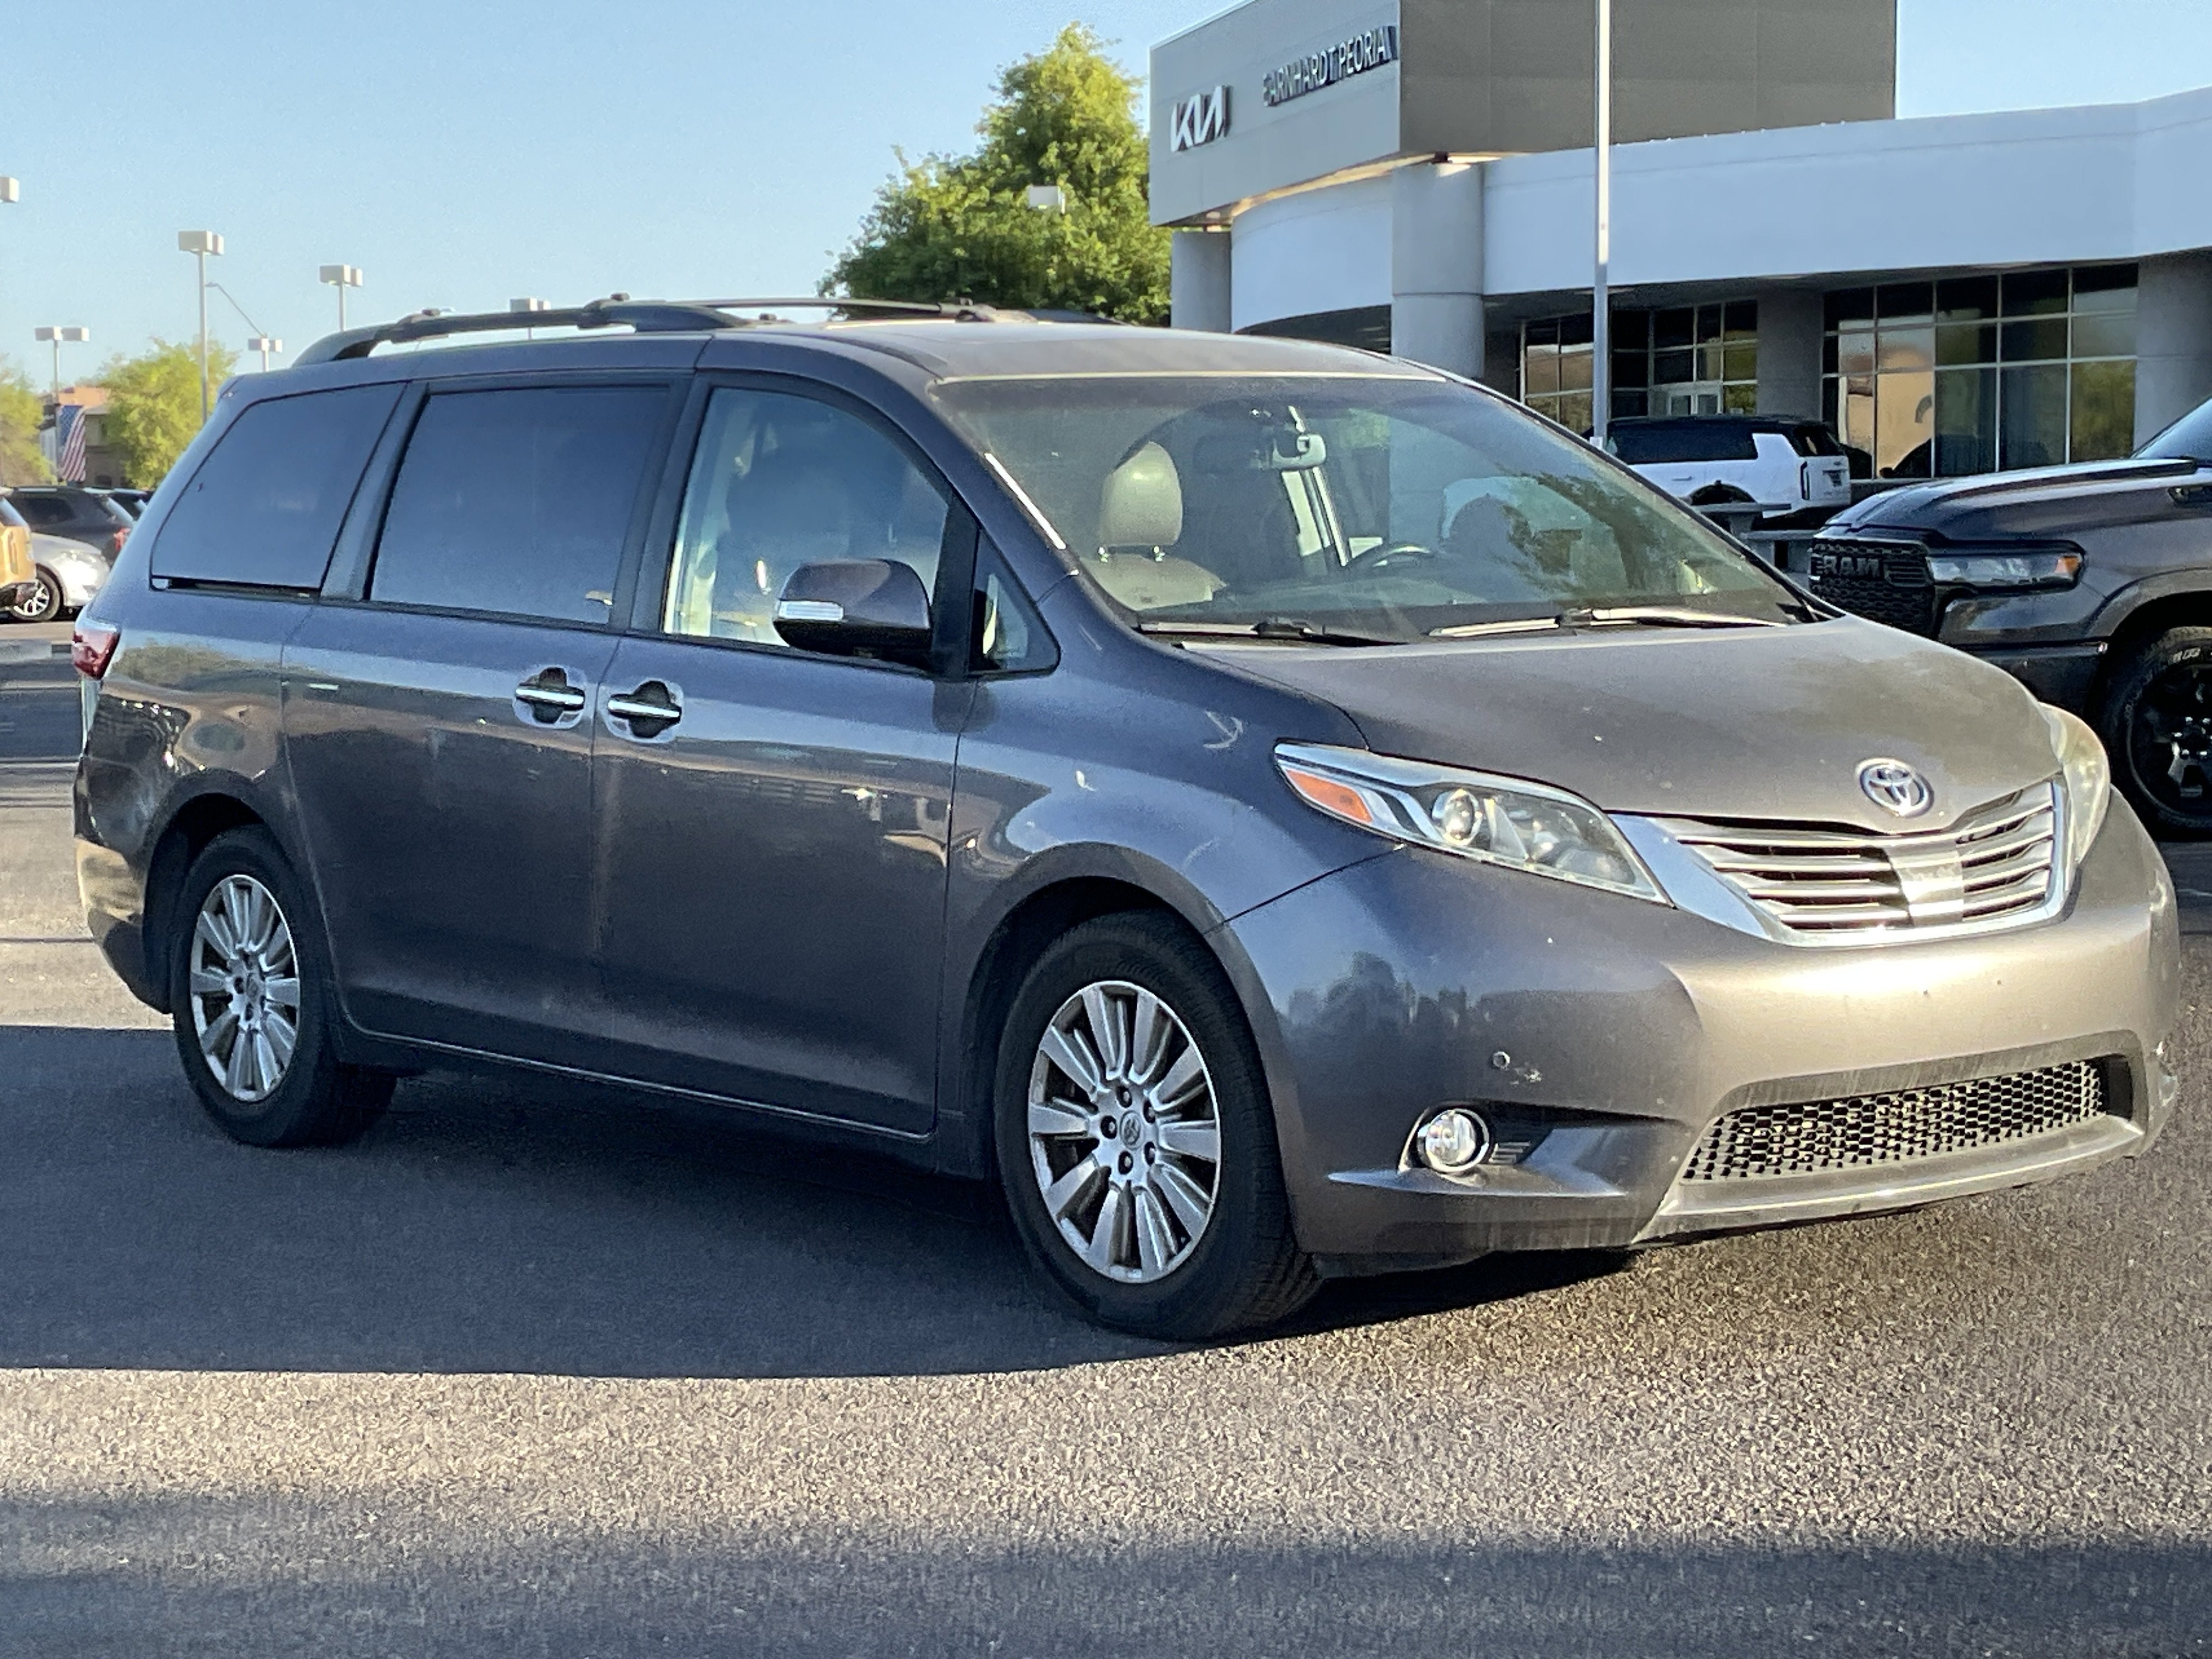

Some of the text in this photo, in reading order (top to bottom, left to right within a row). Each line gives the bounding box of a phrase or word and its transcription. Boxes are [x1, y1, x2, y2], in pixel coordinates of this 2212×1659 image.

[1263, 27, 1394, 106] EARNHARDT PEORIA
[1823, 555, 1881, 577] RAM
